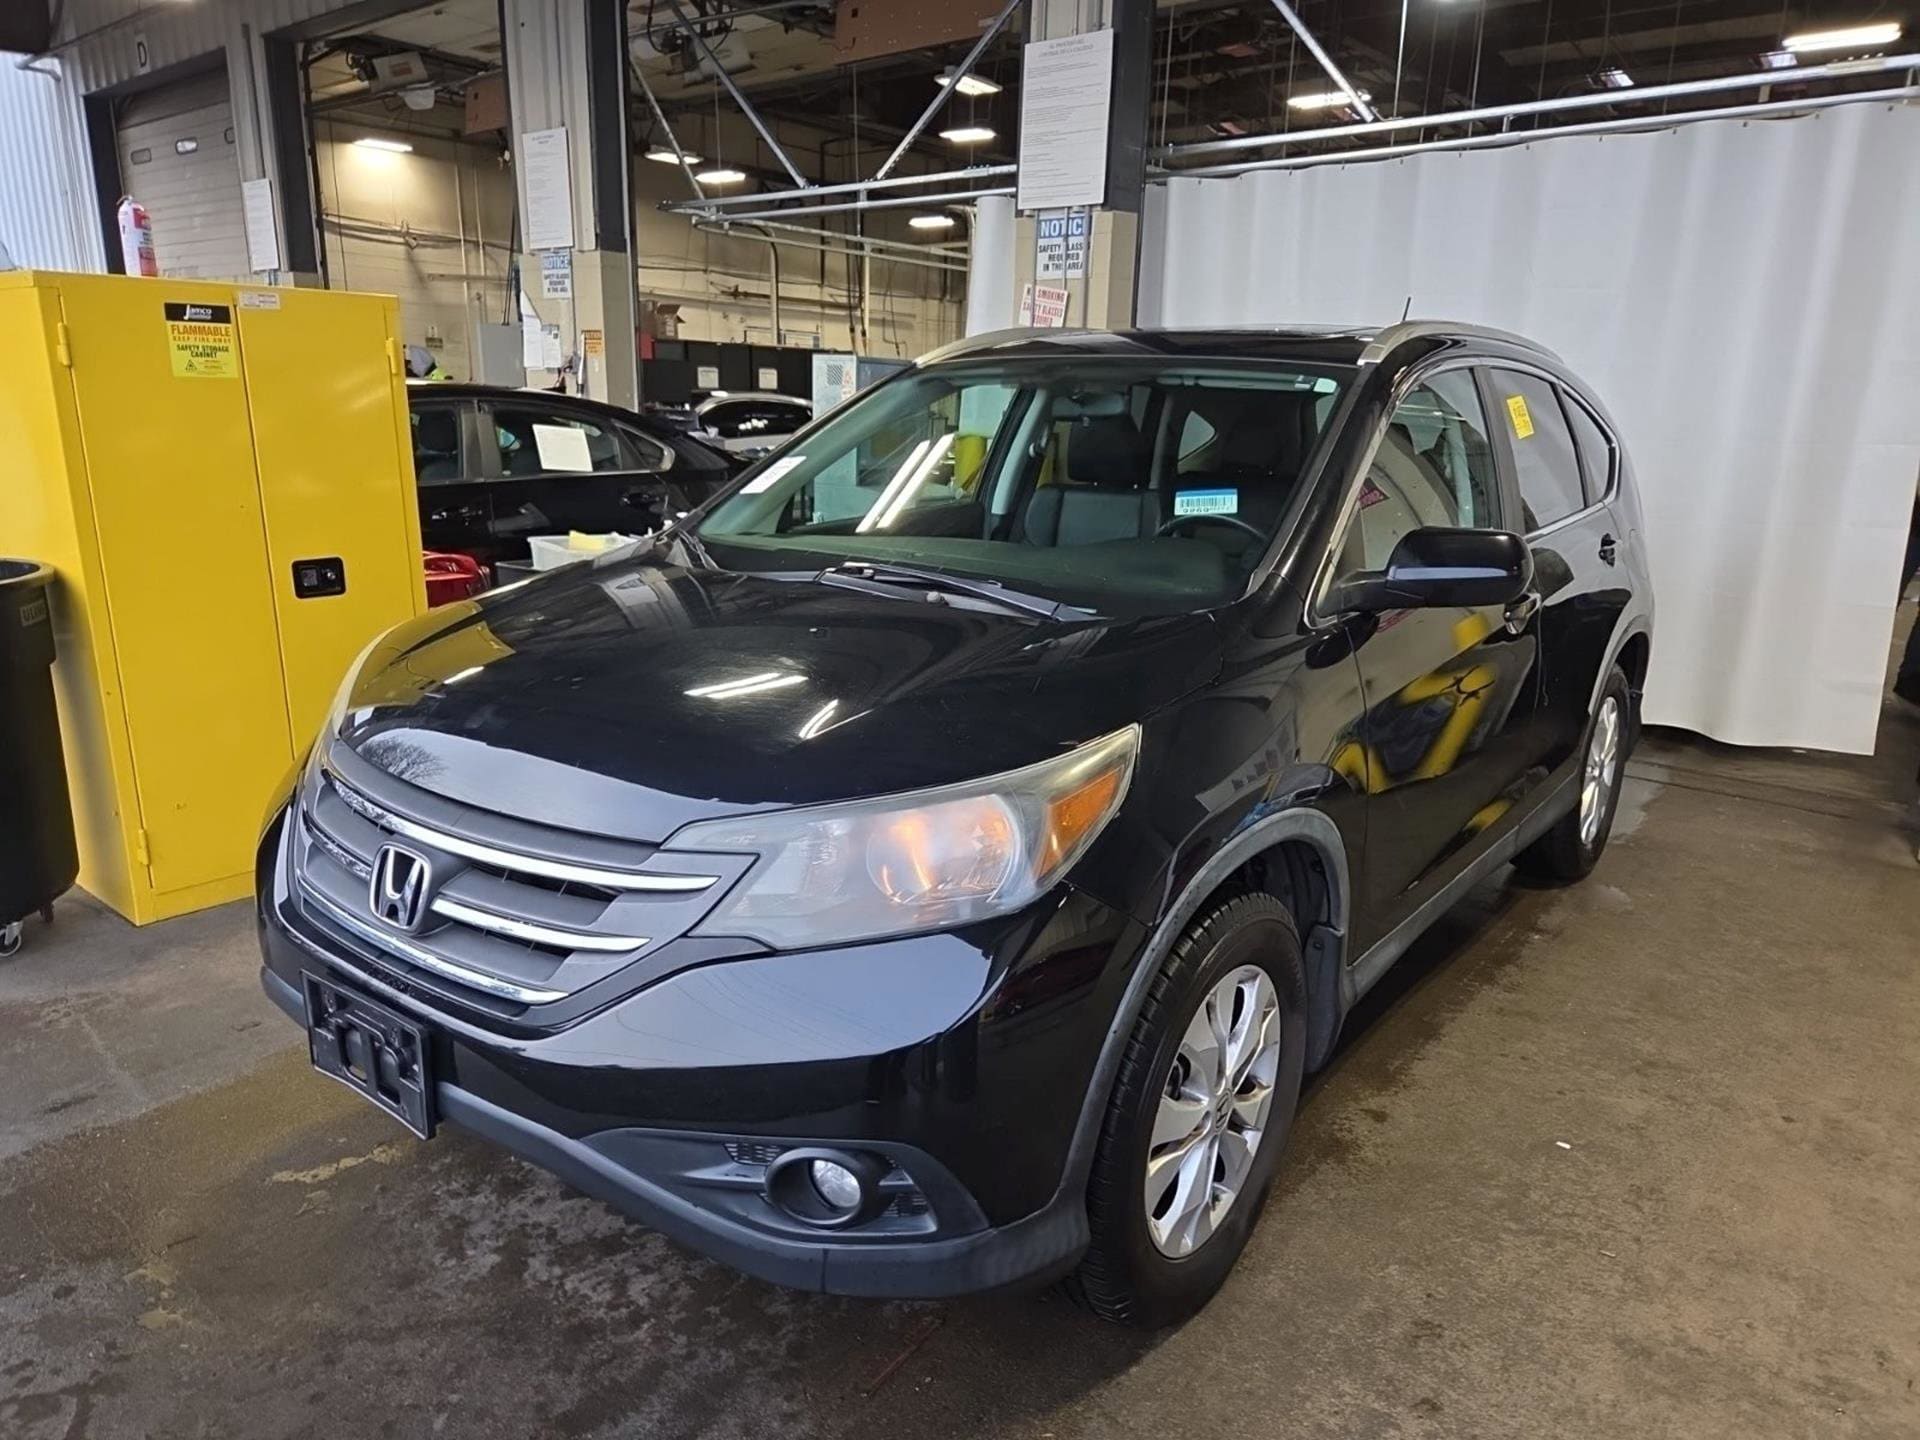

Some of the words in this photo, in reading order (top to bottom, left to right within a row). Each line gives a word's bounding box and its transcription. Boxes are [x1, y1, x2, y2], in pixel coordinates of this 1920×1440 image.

[136, 41, 147, 68] D
[1040, 218, 1084, 237] NOTIC
[1038, 243, 1061, 253] SAFETY
[1048, 252, 1079, 262] REQURED
[1043, 263, 1049, 271] IN
[1037, 289, 1065, 303] SMOKING
[183, 304, 212, 320] Jamco
[170, 324, 231, 337] FLAMMABLE
[201, 345, 229, 353] STORAGE
[190, 351, 217, 359] CABINET
